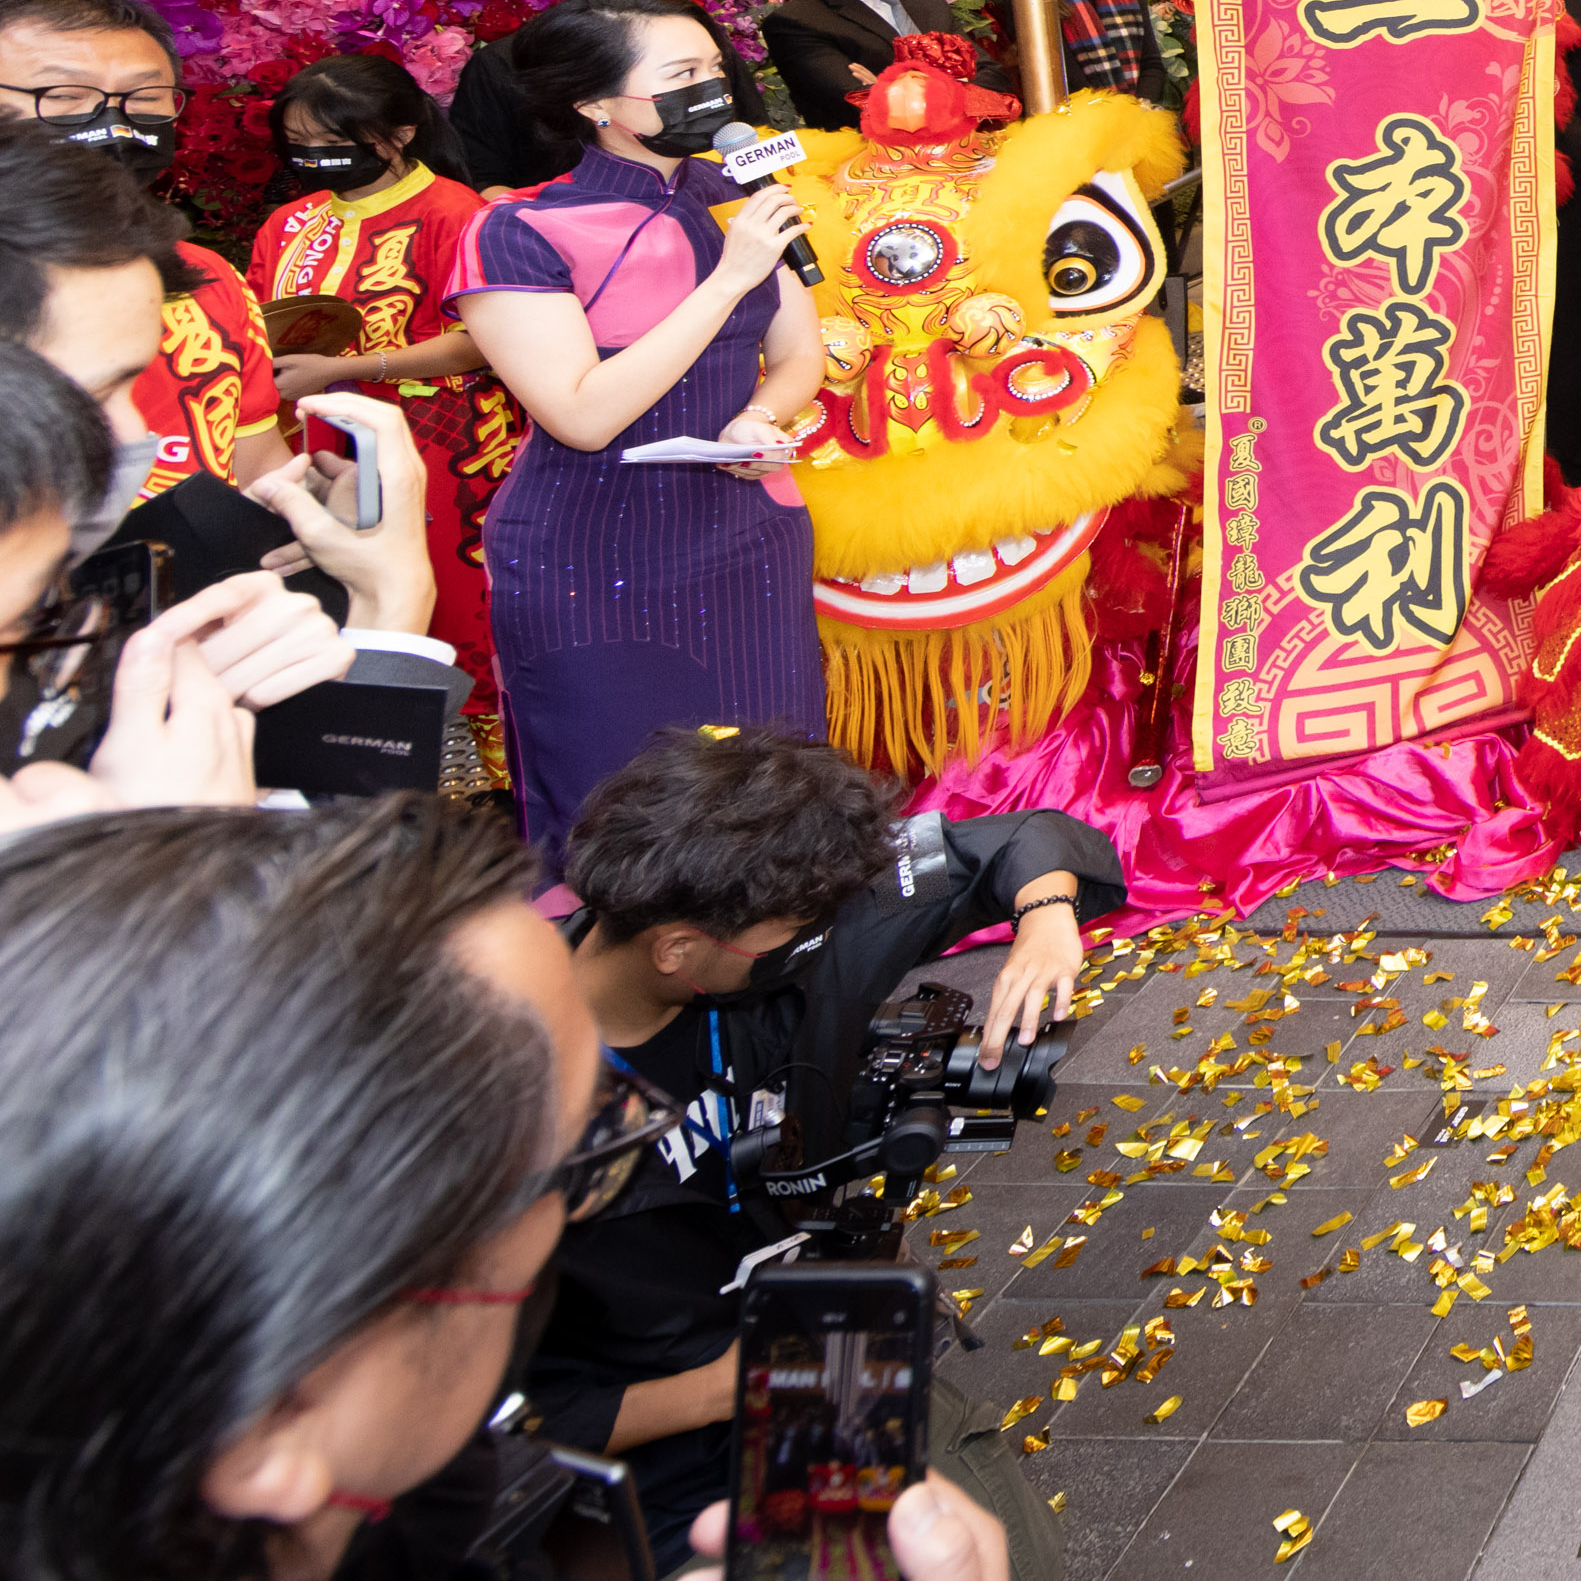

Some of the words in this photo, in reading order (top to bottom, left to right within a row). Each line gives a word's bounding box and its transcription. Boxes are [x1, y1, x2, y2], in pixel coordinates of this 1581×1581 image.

[735, 137, 796, 167] GERMAN
[779, 151, 800, 163] POOL
[1217, 431, 1264, 759] 夏國璋龍獅團致意
[322, 733, 412, 752] GERMAN
[765, 1172, 827, 1197] RONIN
